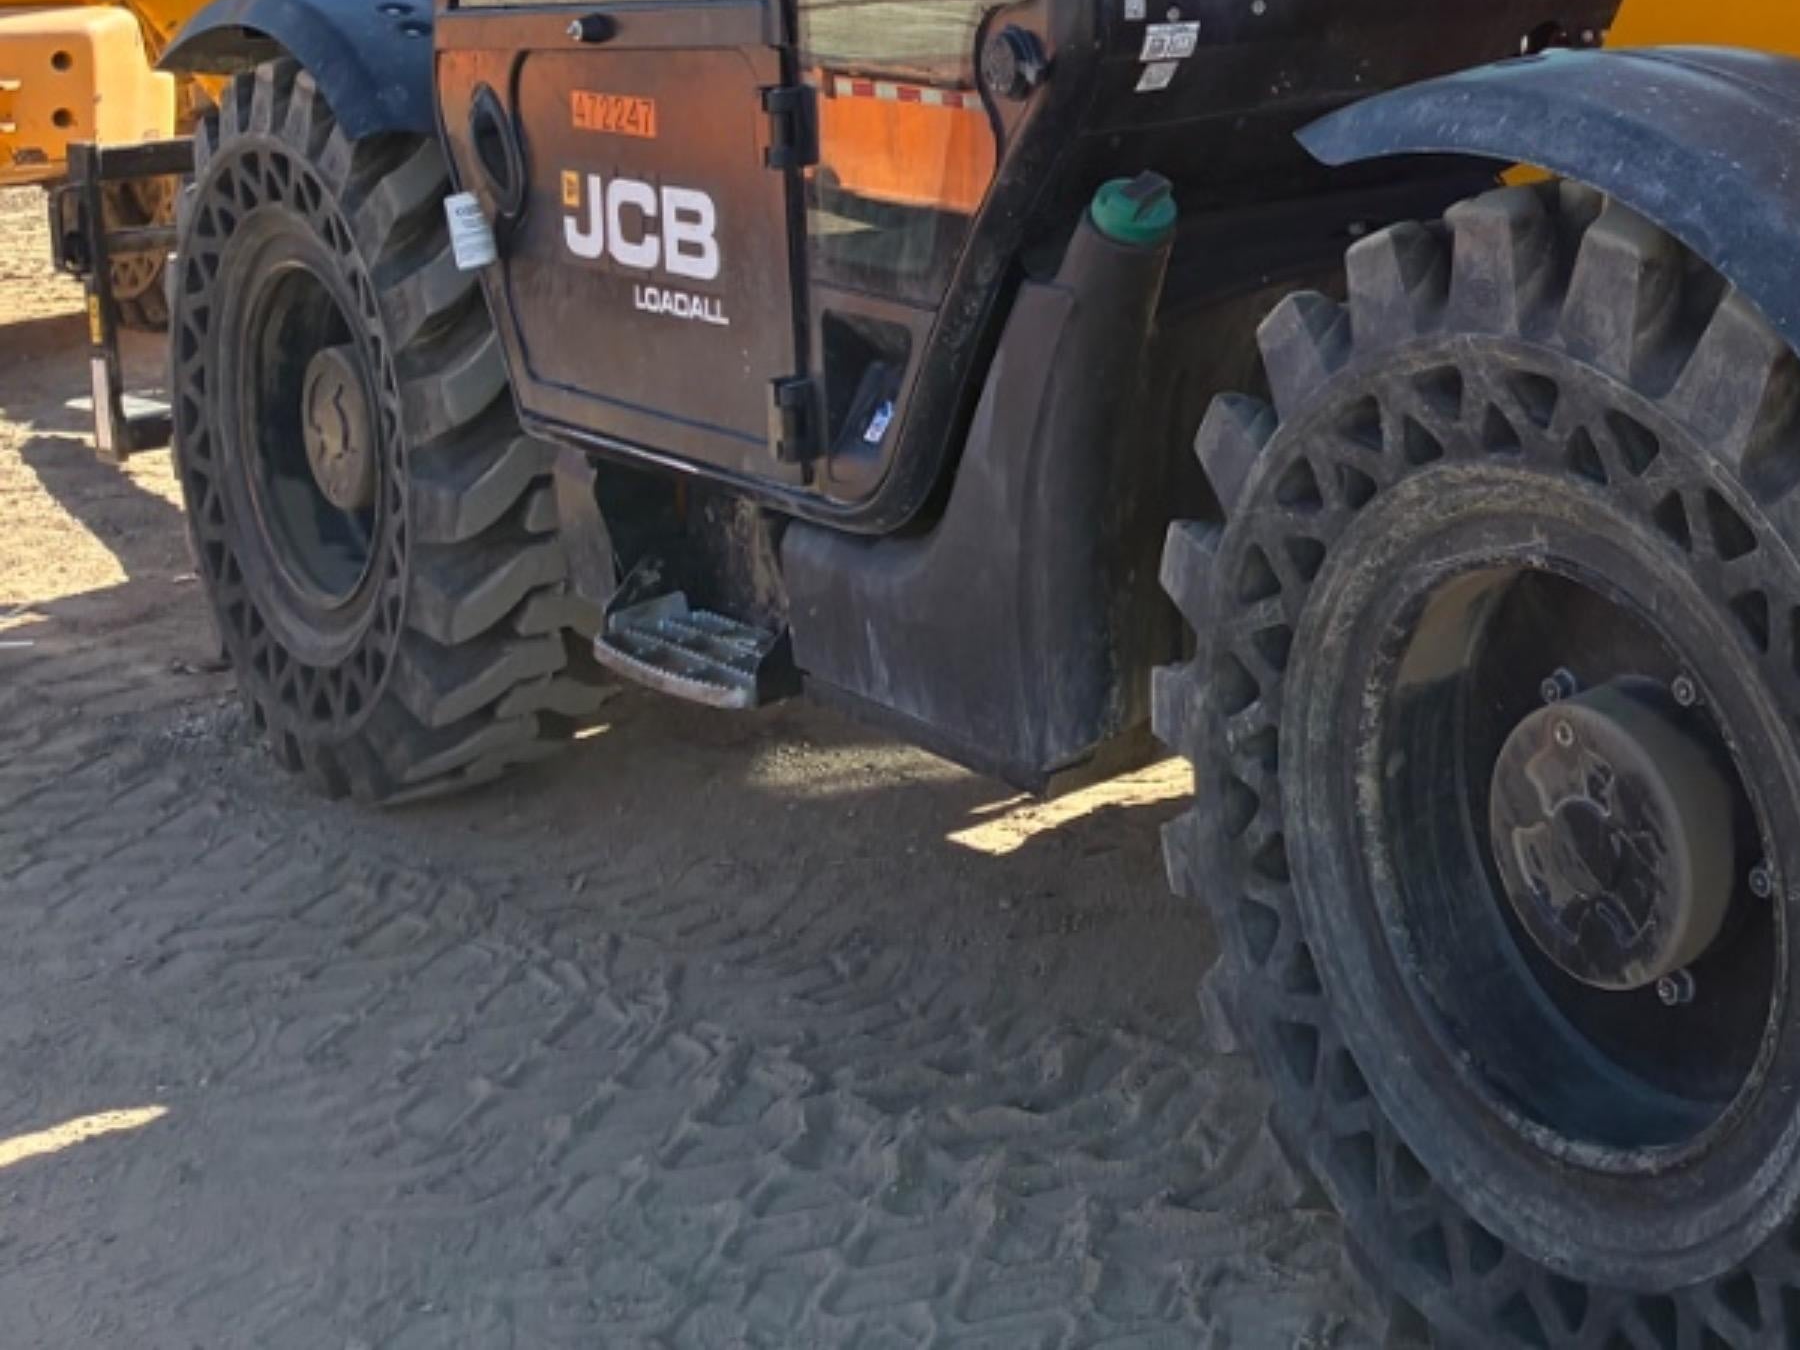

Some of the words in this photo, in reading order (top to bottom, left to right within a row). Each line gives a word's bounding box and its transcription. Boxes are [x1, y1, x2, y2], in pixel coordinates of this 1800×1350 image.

[574, 94, 653, 134] 472247
[563, 172, 721, 281] JCB
[634, 284, 730, 325] LOADALL
